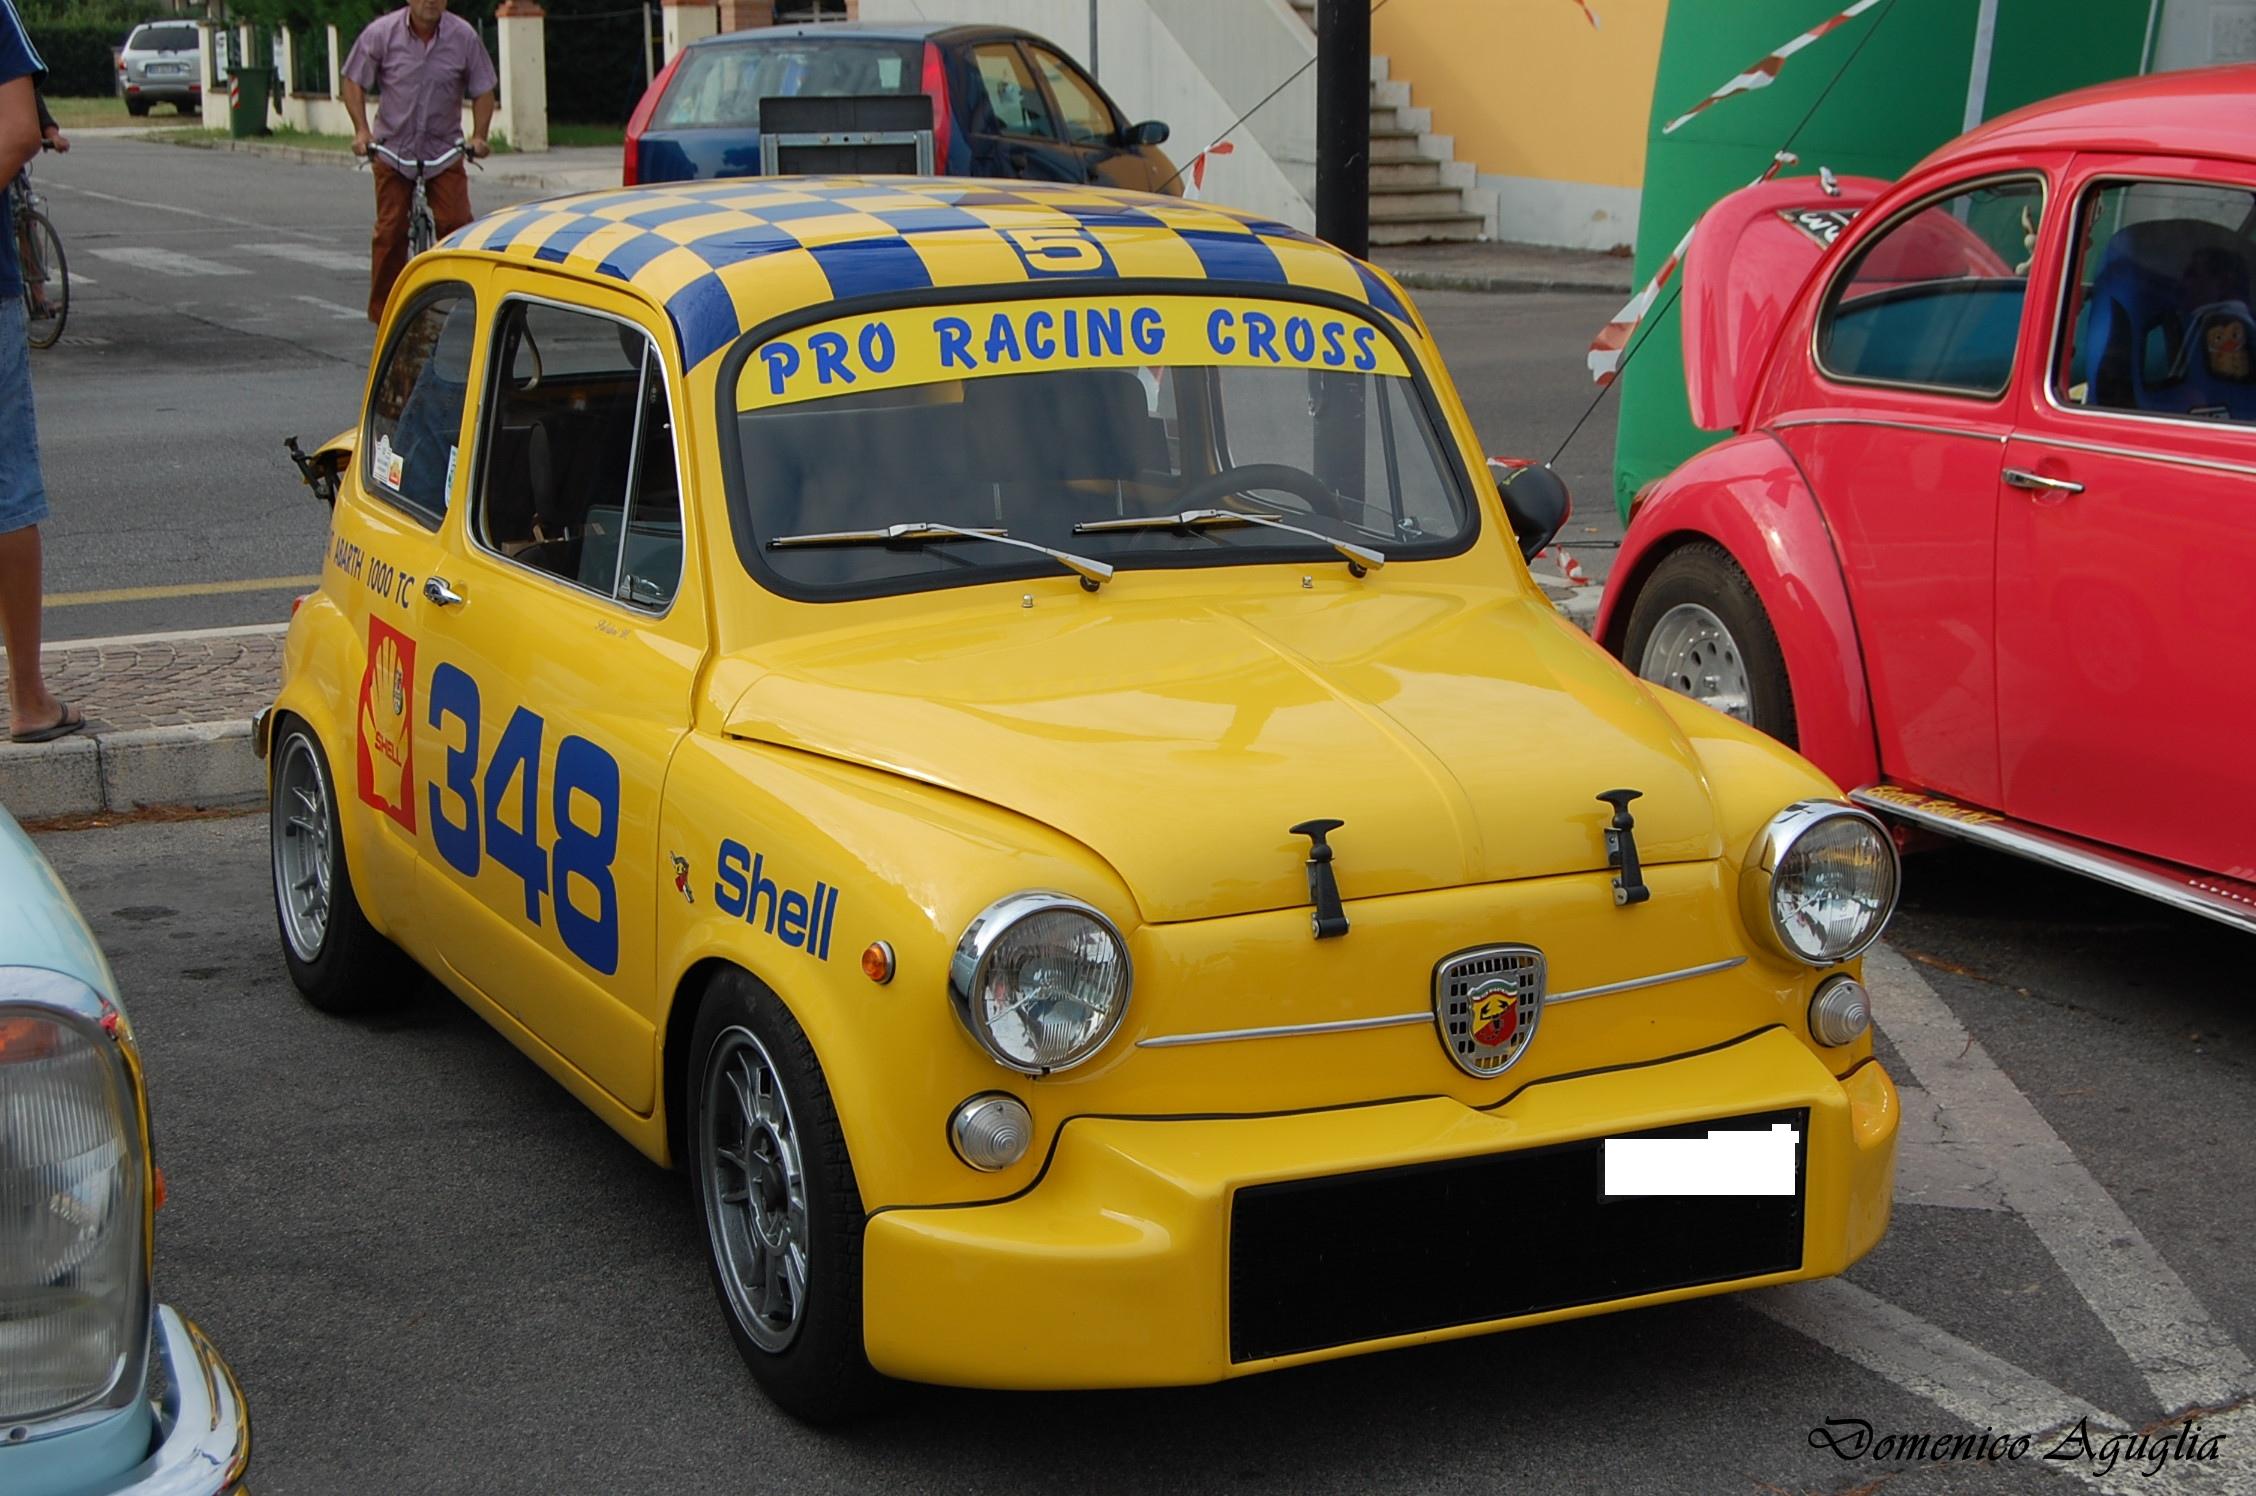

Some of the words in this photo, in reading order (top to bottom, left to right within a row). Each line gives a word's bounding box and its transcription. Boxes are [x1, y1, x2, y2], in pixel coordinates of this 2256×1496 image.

[1007, 228, 1103, 271] 5
[760, 321, 896, 395] PRO
[933, 307, 1165, 370] RACING
[1207, 308, 1378, 371] CROSS
[333, 535, 365, 581] ABARTH
[366, 556, 394, 598] 1000
[395, 571, 415, 609] TC
[374, 730, 402, 767] SHELL
[428, 661, 621, 976] 348
[714, 838, 839, 961] Shell
